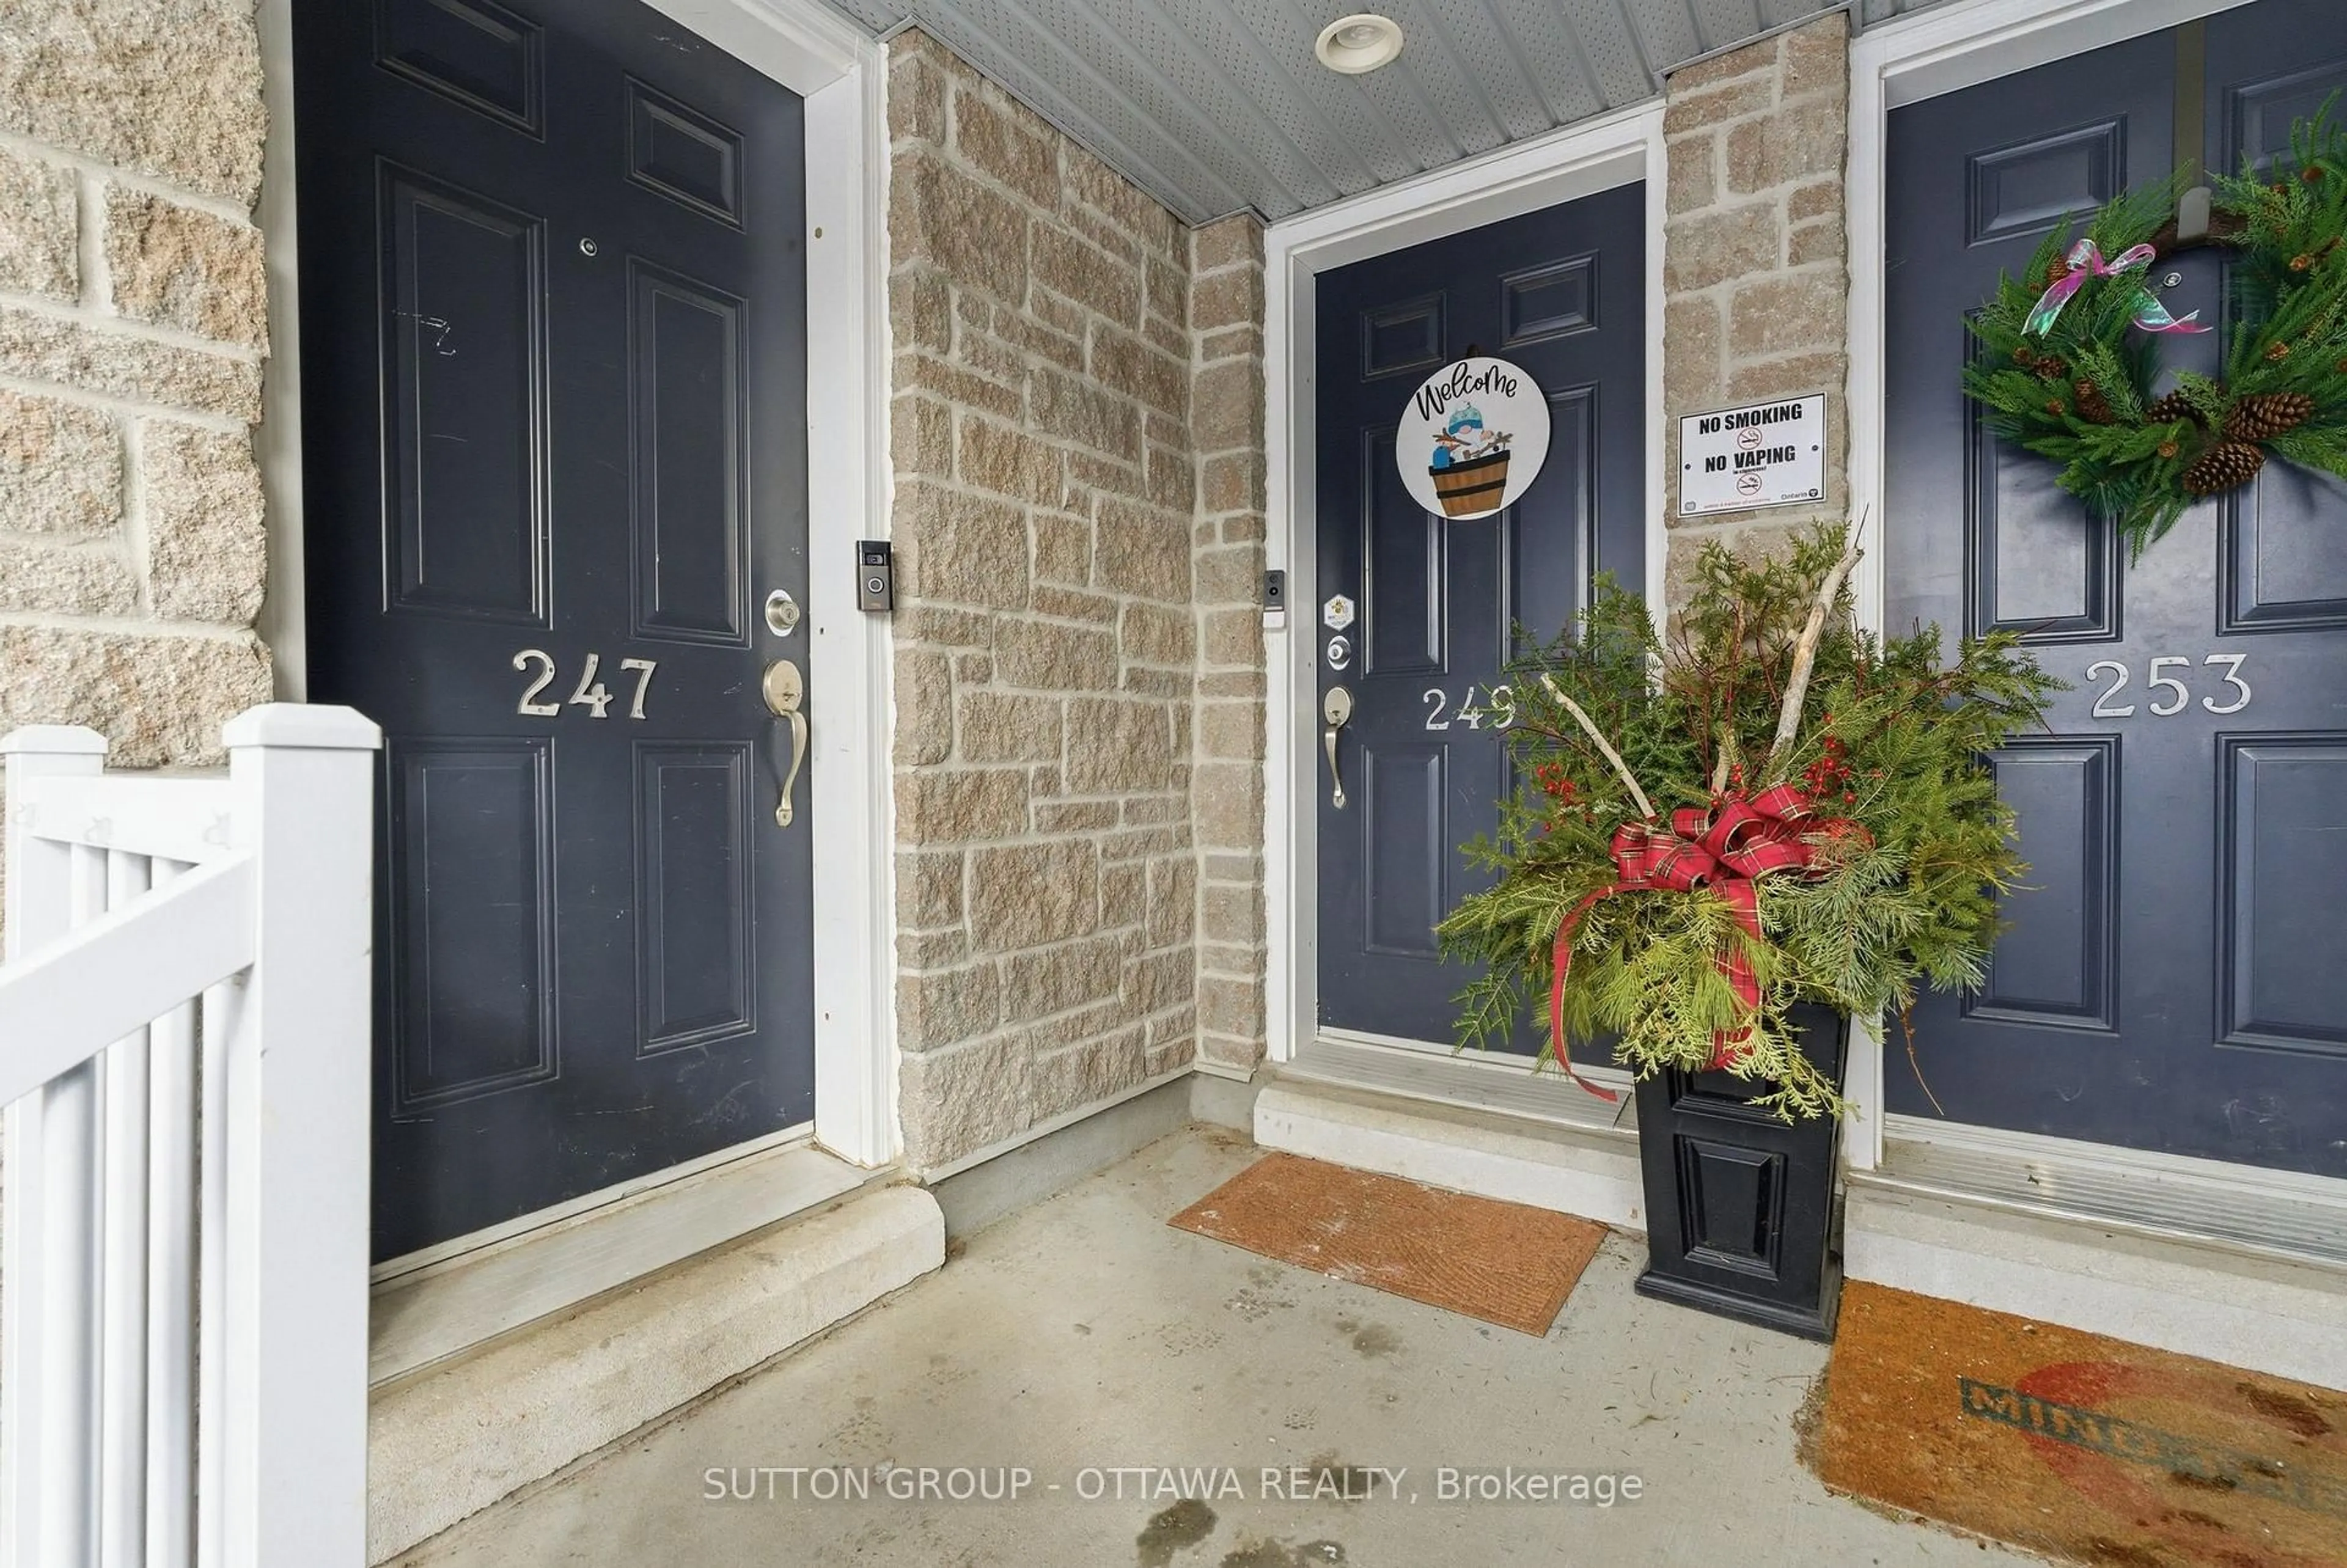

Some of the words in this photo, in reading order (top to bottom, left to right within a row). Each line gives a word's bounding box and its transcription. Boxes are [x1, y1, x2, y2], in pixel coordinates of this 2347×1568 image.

[1416, 361, 1518, 422] Welcome
[1699, 417, 1721, 435] NO
[1724, 403, 1803, 431] SMOKING
[1705, 455, 1727, 473] NO
[1733, 445, 1796, 469] VAPING
[512, 648, 658, 720] 247
[1422, 685, 1517, 731] 249
[2085, 653, 2252, 718] 253
